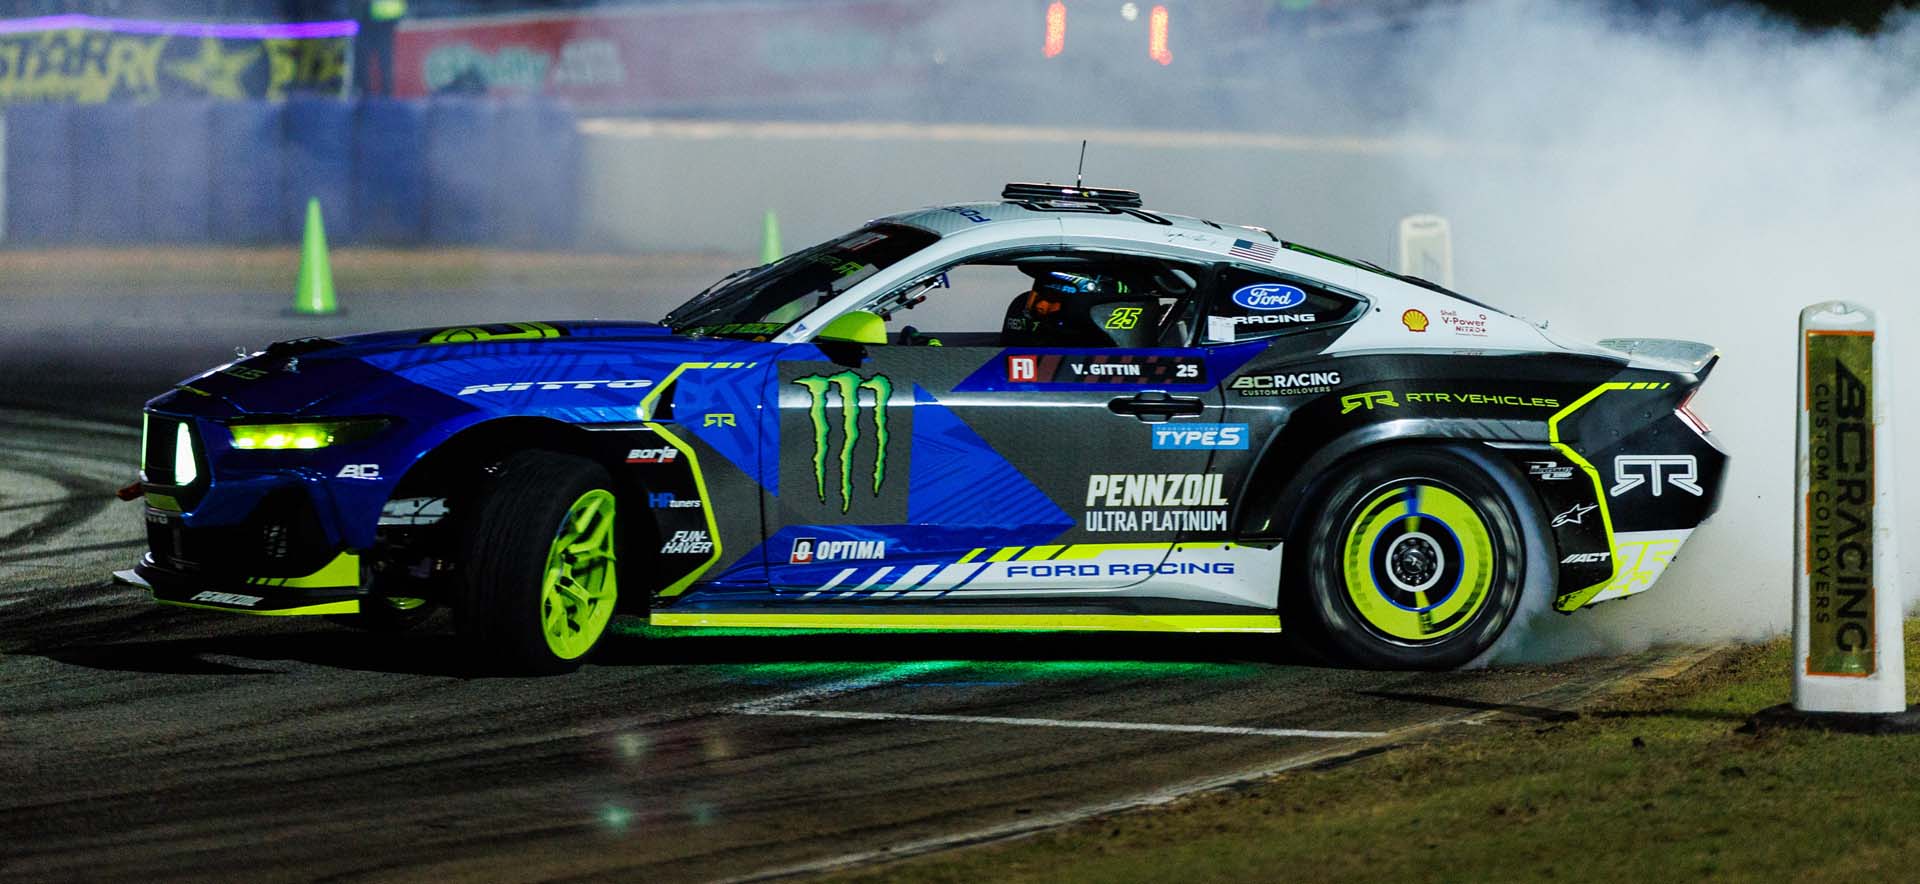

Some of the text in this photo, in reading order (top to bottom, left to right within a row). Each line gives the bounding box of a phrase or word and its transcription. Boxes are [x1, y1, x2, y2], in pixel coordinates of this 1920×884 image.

[1247, 287, 1292, 305] Ford
[1104, 307, 1143, 329] 25
[1231, 313, 1316, 325] RACING
[1441, 316, 1485, 327] V-Power
[1011, 358, 1034, 379] FD
[1090, 363, 1141, 376] GITTIN
[1176, 364, 1199, 378] 25
[457, 379, 653, 396] NITTO
[1281, 386, 1331, 395] COILOVERS
[1405, 393, 1560, 408] RTR VEHICLES
[335, 463, 380, 478] BC
[1086, 474, 1228, 507] PENNZOIL
[1815, 383, 1830, 625] CUSTOM COILOVERS
[1086, 511, 1227, 532] ULTRA PLATINUM
[671, 530, 708, 543] FUN-
[660, 541, 713, 554] HAVER
[816, 540, 886, 560] OPTIMA
[1007, 562, 1235, 578] FORD RACING
